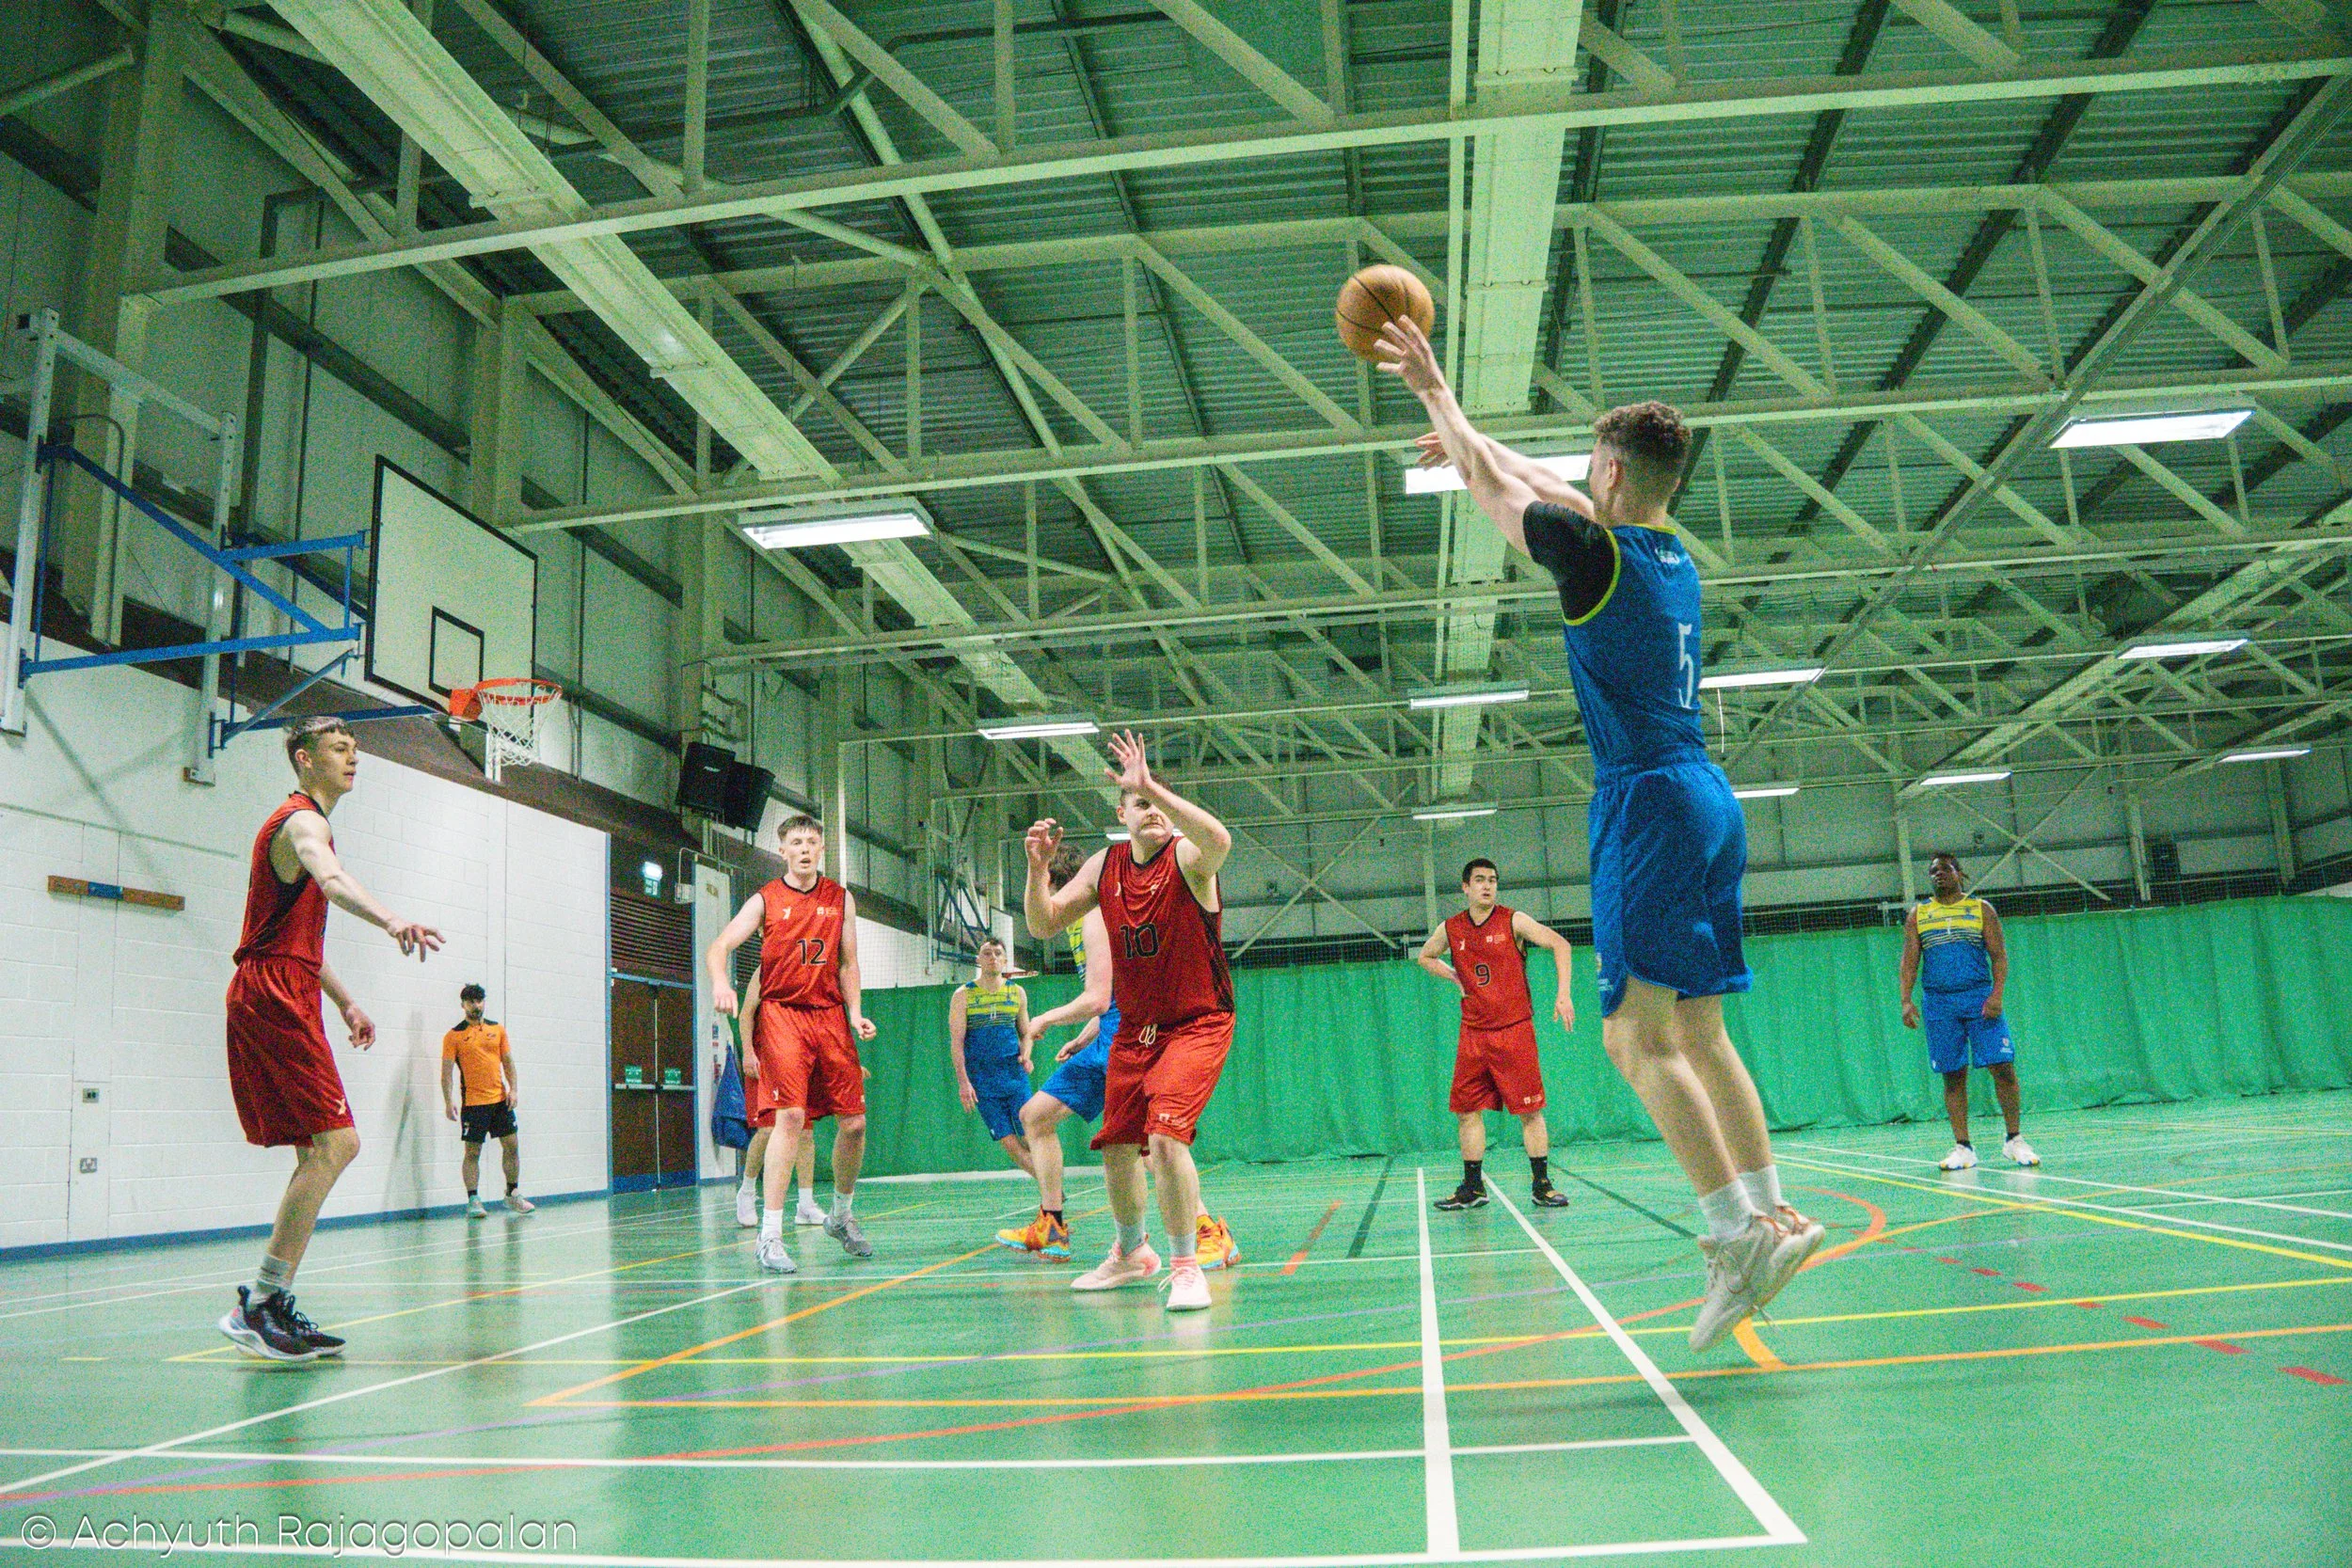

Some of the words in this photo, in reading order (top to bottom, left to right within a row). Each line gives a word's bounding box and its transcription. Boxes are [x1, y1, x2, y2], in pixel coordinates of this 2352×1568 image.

[1677, 622, 1694, 709] 5
[797, 938, 827, 965] 12
[1120, 923, 1159, 959] 10
[1474, 963, 1491, 987] 9
